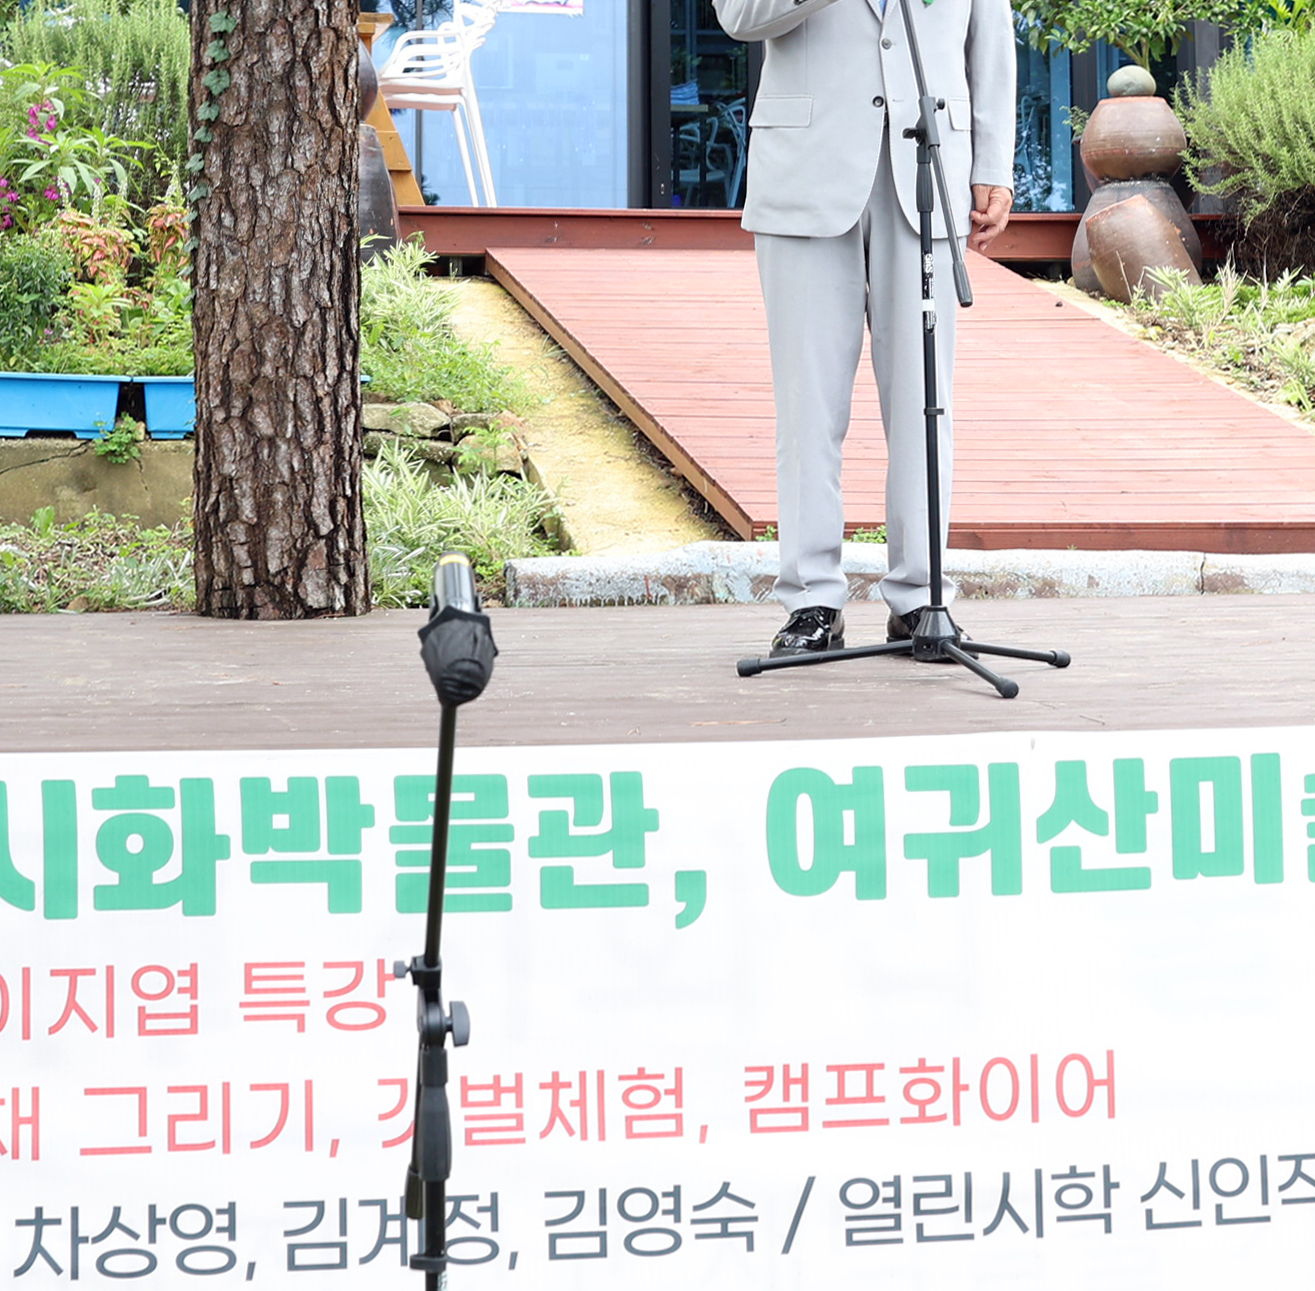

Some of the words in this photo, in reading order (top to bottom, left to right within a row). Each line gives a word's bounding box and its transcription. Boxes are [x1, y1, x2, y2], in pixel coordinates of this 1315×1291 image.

[239, 959, 398, 1033] 특강
[80, 1080, 339, 1157] 그리기,
[745, 1050, 1115, 1133] 캠프화이어
[14, 1202, 255, 1280] 차상영,
[286, 1192, 520, 1272] 김계정,
[545, 1182, 758, 1260] 김영숙
[840, 1165, 1119, 1246] 열린시학
